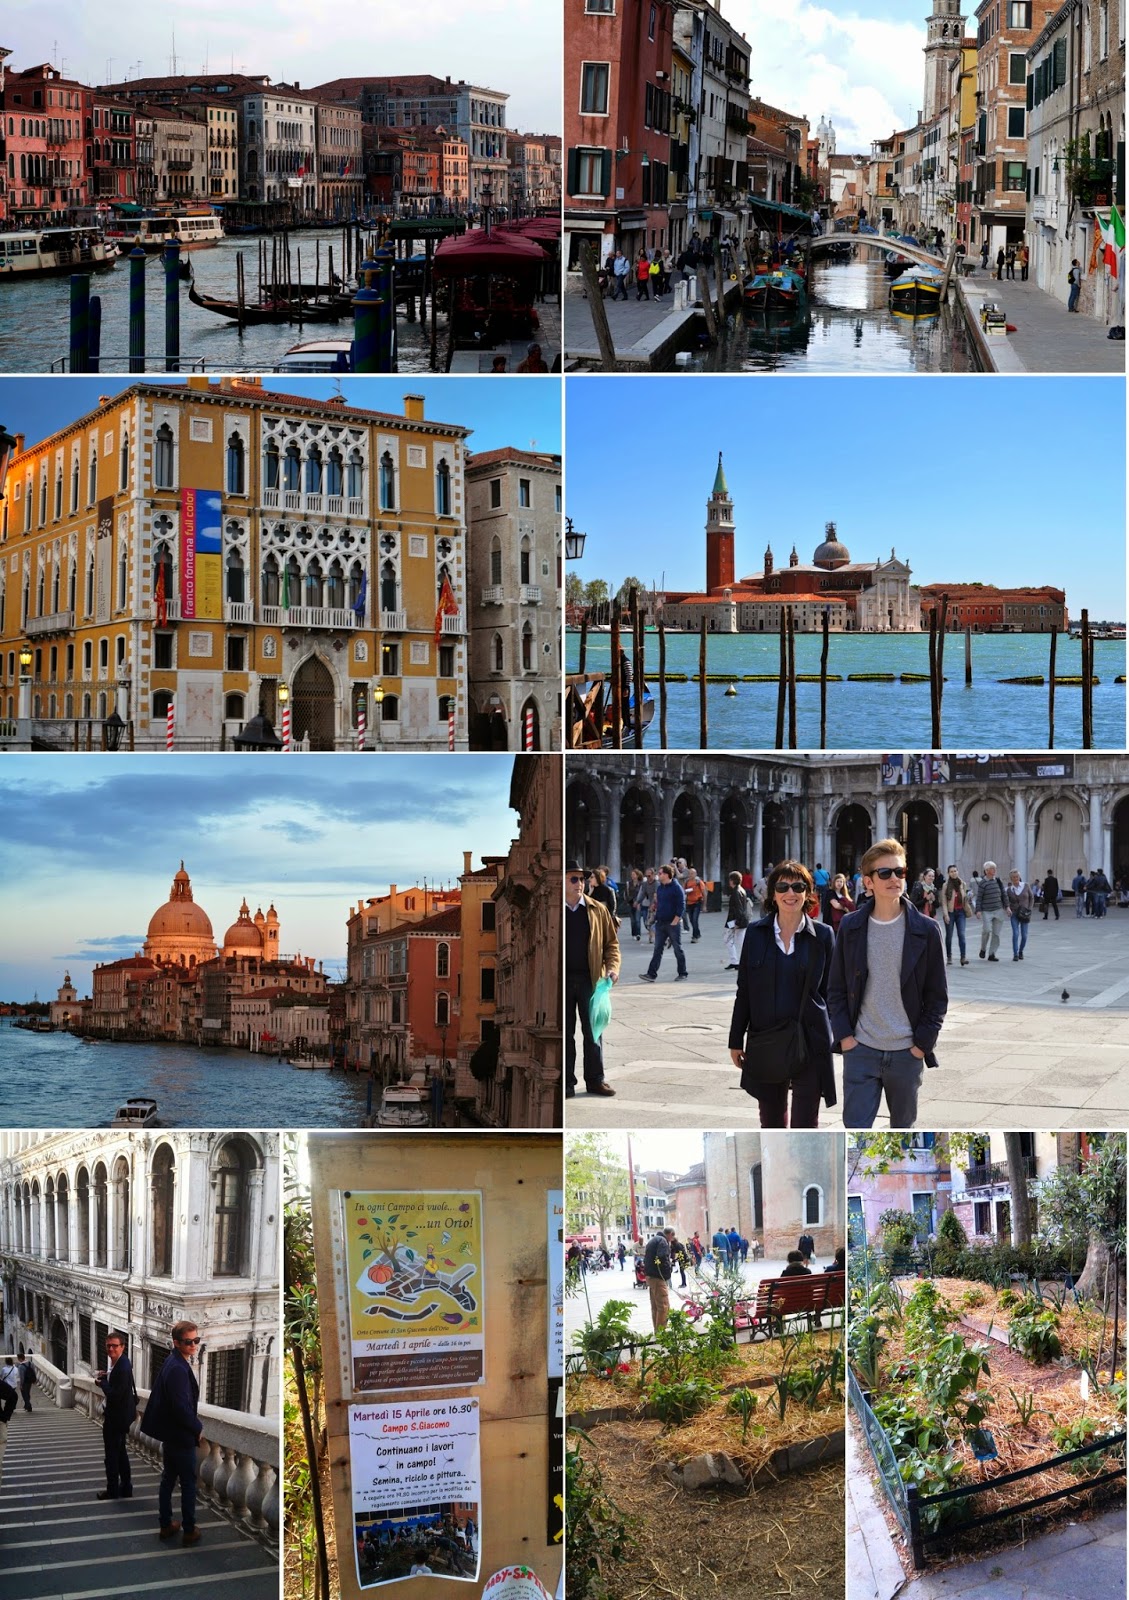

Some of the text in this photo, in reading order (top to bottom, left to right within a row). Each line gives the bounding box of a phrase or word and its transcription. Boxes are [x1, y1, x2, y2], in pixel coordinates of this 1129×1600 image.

[185, 492, 194, 615] franco fontana full color
[367, 1203, 384, 1213] ogni
[388, 1203, 415, 1213] Campo
[445, 1218, 473, 1228] Orto!
[409, 1339, 430, 1350] aprile
[354, 1410, 388, 1421] Martedì
[393, 1410, 402, 1418] 15
[405, 1408, 430, 1419] Aprile
[449, 1405, 471, 1414] 16.30
[382, 1421, 449, 1434] Campo S.Giacomo
[376, 1442, 454, 1456] Continuano i lavori
[397, 1457, 436, 1469] in campo!
[373, 1477, 402, 1486] Semina,
[405, 1473, 427, 1483] riciclo
